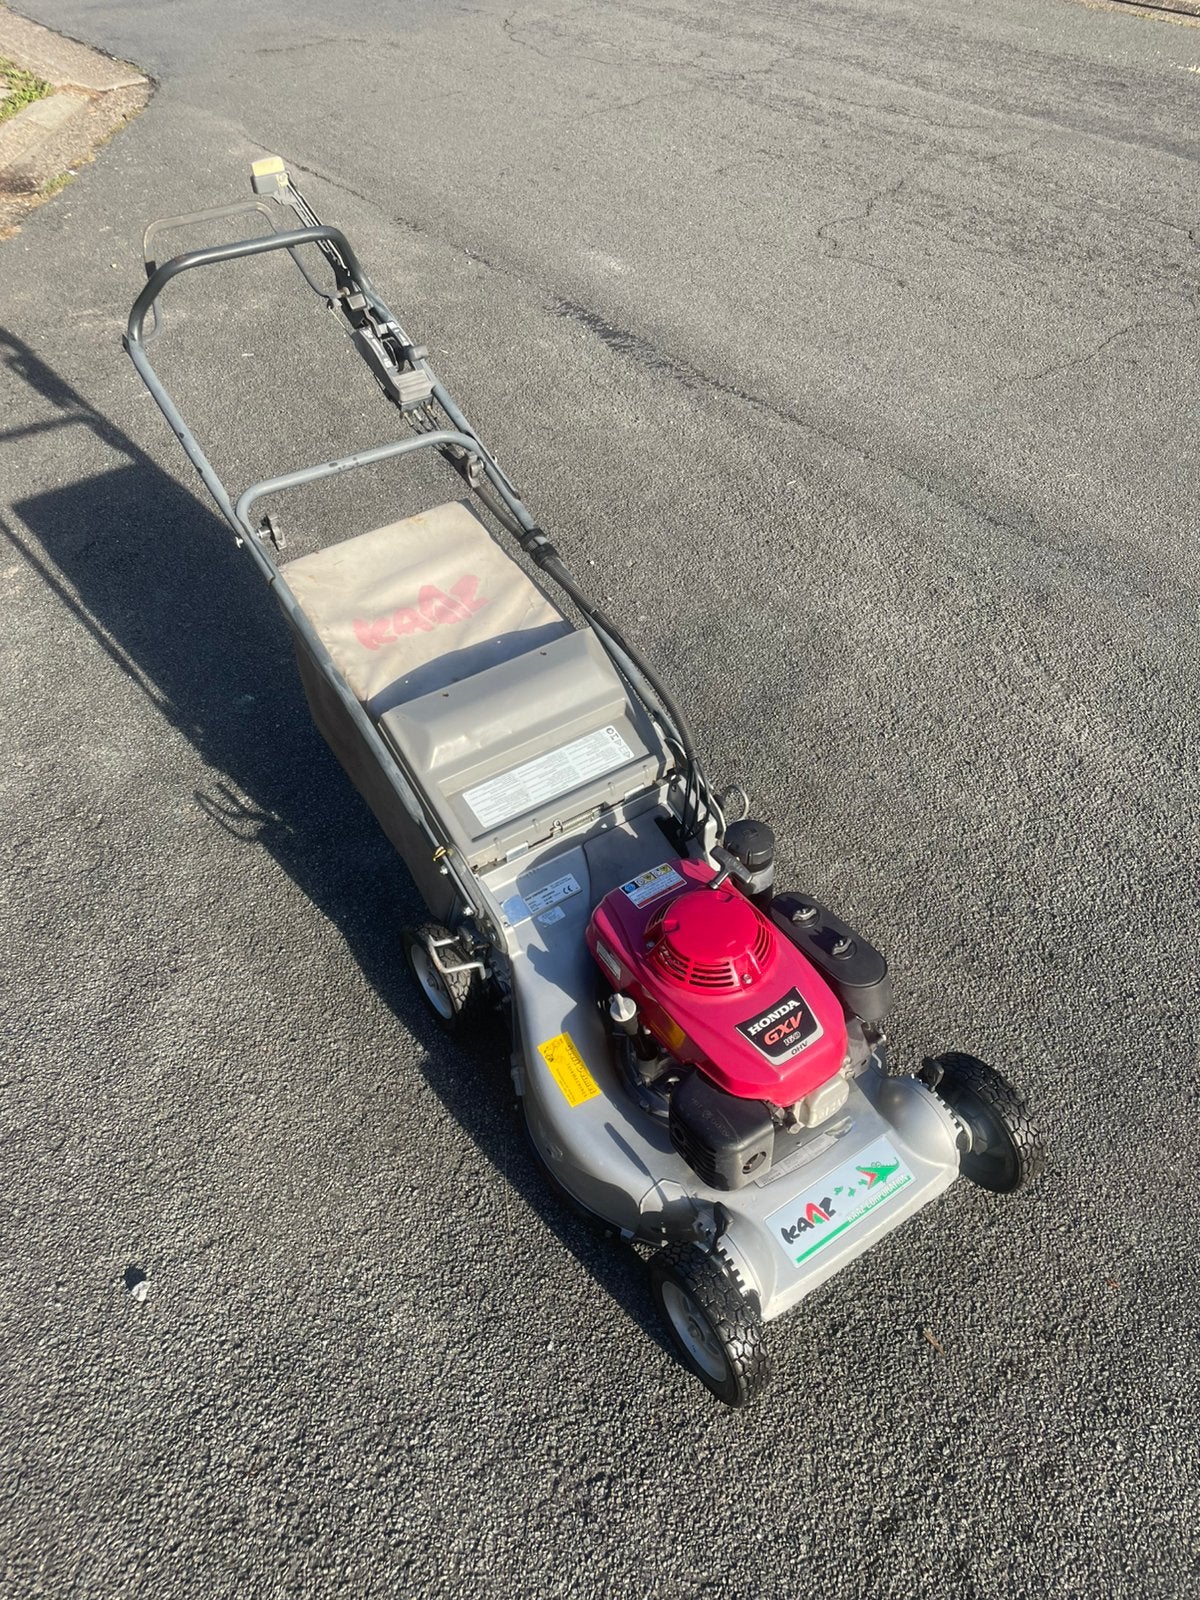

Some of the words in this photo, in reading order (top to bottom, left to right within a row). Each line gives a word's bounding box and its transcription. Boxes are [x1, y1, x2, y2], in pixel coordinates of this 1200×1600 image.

[747, 1000, 800, 1036] HONDA
[764, 1011, 802, 1045] GXV
[791, 1041, 808, 1055] OHV
